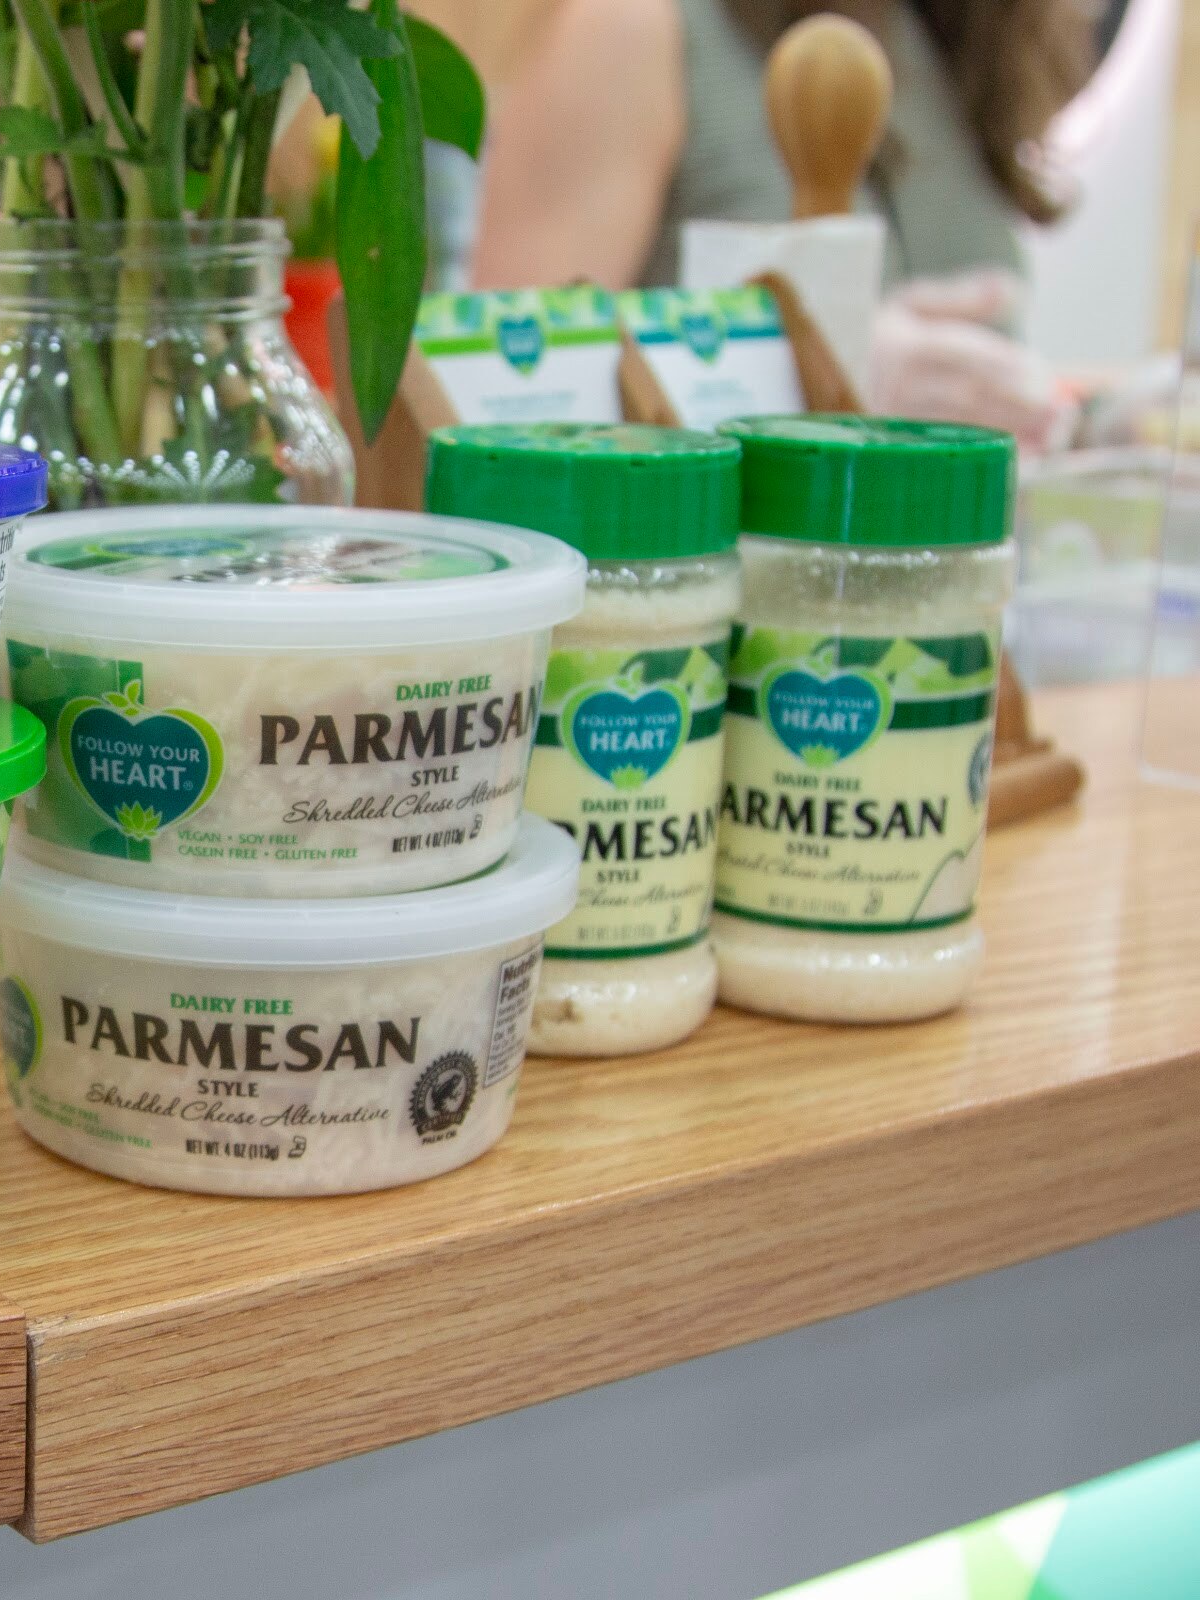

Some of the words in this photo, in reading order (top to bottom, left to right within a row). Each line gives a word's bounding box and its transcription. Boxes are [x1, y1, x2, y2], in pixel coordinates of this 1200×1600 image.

[395, 680, 452, 702] DAIRY
[458, 674, 492, 695] FREE
[579, 714, 638, 728] FOLLOW
[782, 708, 860, 732] HEART
[77, 735, 144, 758] FOLLOW
[149, 744, 200, 763] YOUR
[590, 729, 666, 753] HEART
[89, 757, 186, 791] HEART
[411, 765, 460, 787] STYLE
[774, 771, 819, 789] DAIRY
[283, 793, 394, 823] Shredded
[392, 791, 454, 819] Cheese
[581, 798, 630, 814] DAIRY
[720, 780, 948, 841] ARMESAN
[177, 831, 221, 843] VEGAN
[238, 834, 266, 845] SOY
[269, 833, 298, 845] FREE
[177, 844, 225, 858] CASEIN
[229, 848, 258, 860] FREE
[275, 849, 326, 860] GLUTEN
[331, 847, 358, 859] FREE
[169, 992, 236, 1013] DAIRY
[244, 999, 293, 1015] FREE
[61, 995, 421, 1073] PARMESAN
[198, 1078, 259, 1098] STYLE
[86, 1082, 180, 1118] Shredded
[180, 1101, 257, 1126] Cheese
[261, 1104, 391, 1128] Alternative
